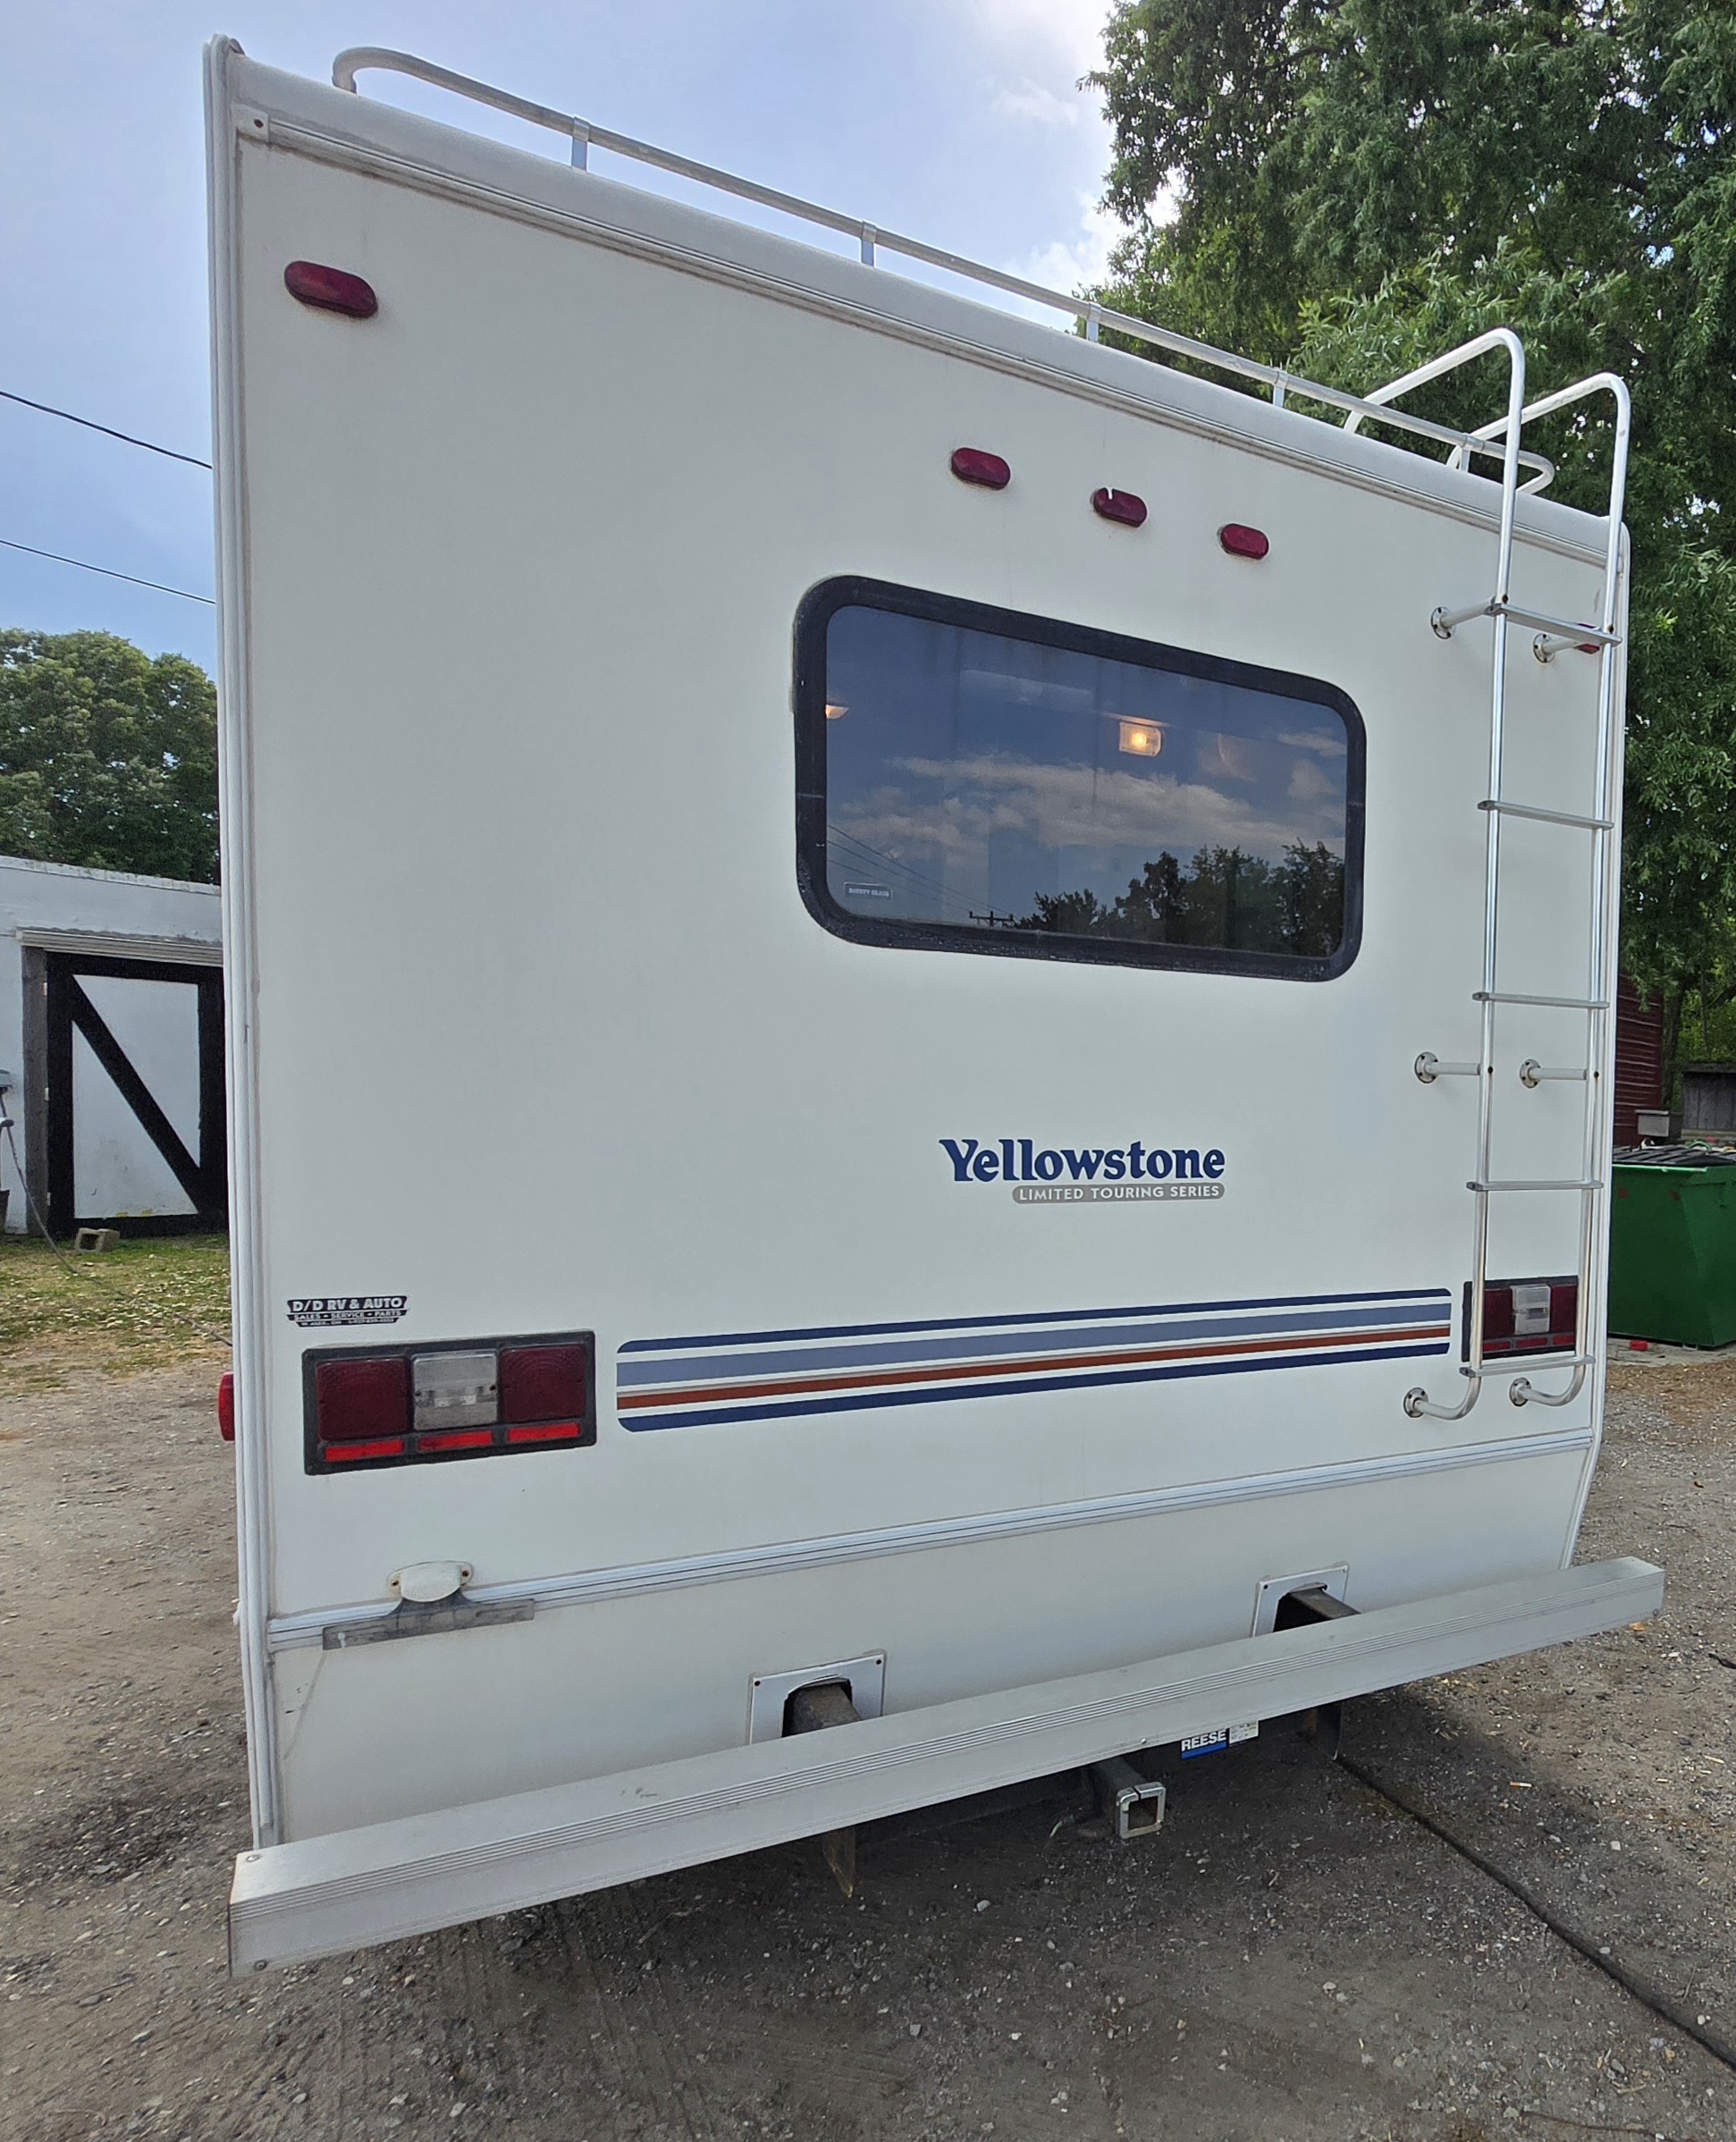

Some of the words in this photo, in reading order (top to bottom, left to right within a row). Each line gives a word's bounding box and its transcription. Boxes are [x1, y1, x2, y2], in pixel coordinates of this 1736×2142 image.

[939, 1139, 1226, 1182] Yellowstone
[1019, 1187, 1084, 1201] LIMITED
[1091, 1185, 1165, 1199] TOURING
[1170, 1185, 1220, 1198] SERIES
[292, 1300, 324, 1311] D/D
[327, 1299, 347, 1311] RV
[349, 1299, 359, 1310] &
[362, 1297, 403, 1309] AUTO
[294, 1313, 321, 1321] SALES
[1181, 1729, 1226, 1752] REESE
